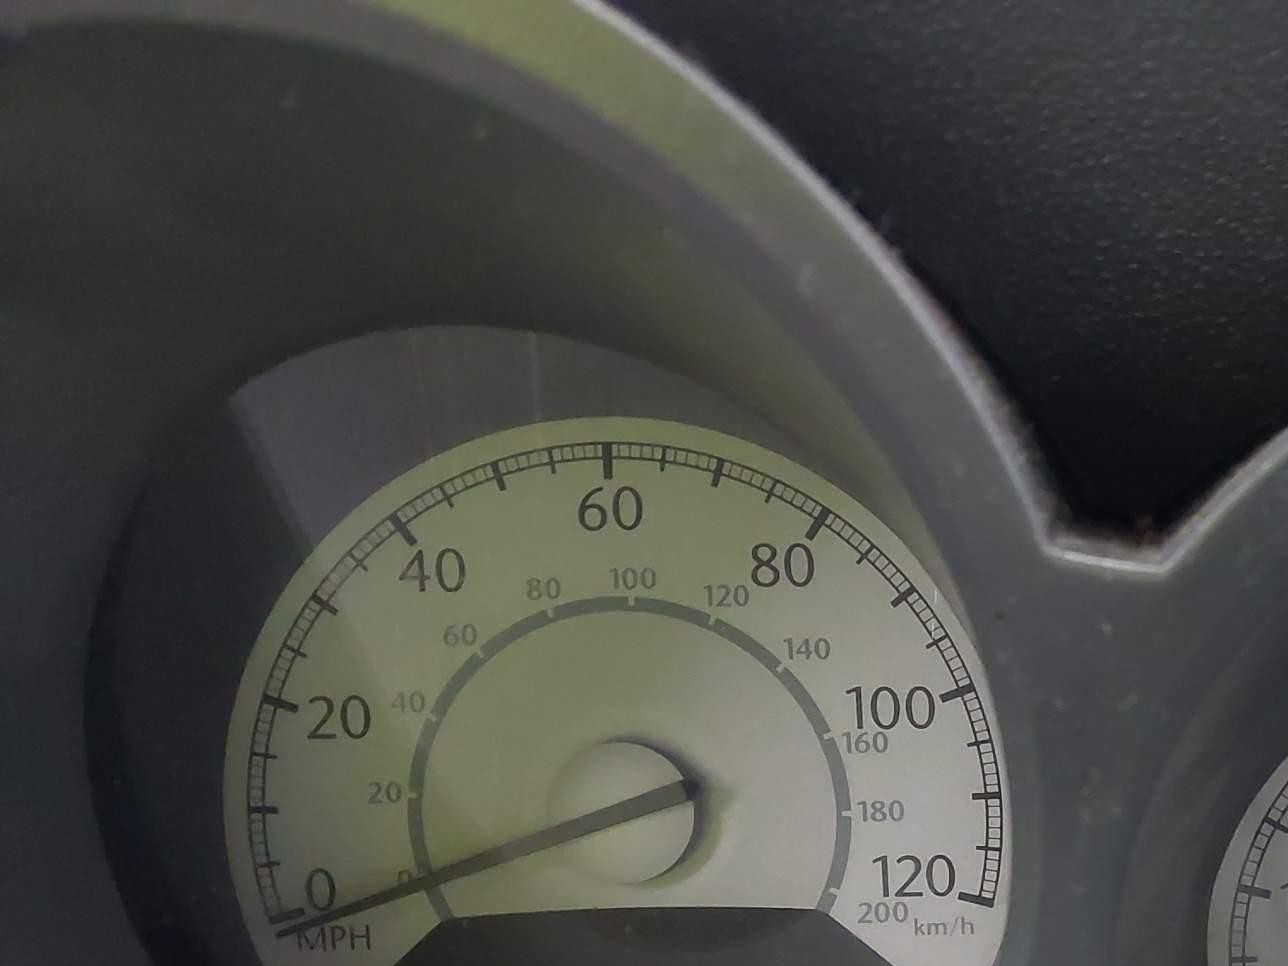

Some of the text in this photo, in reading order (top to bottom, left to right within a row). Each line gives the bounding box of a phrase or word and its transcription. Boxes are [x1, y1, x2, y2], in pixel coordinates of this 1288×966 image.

[577, 486, 643, 532] 60
[399, 548, 466, 592] 40
[750, 542, 815, 588] 80
[526, 578, 561, 600] 80
[608, 567, 657, 590] 100
[703, 584, 750, 607] 120
[443, 624, 478, 646] 60
[783, 637, 831, 660] 140
[391, 691, 426, 713] 40
[846, 686, 935, 730] 100
[306, 695, 371, 740] 20
[842, 731, 889, 754] 160
[367, 782, 401, 804] 20
[856, 800, 905, 823] 180
[871, 854, 956, 898] 120
[305, 868, 336, 912] 0
[857, 902, 909, 923] 200
[913, 917, 975, 936] km/h
[297, 924, 371, 953] MPH
